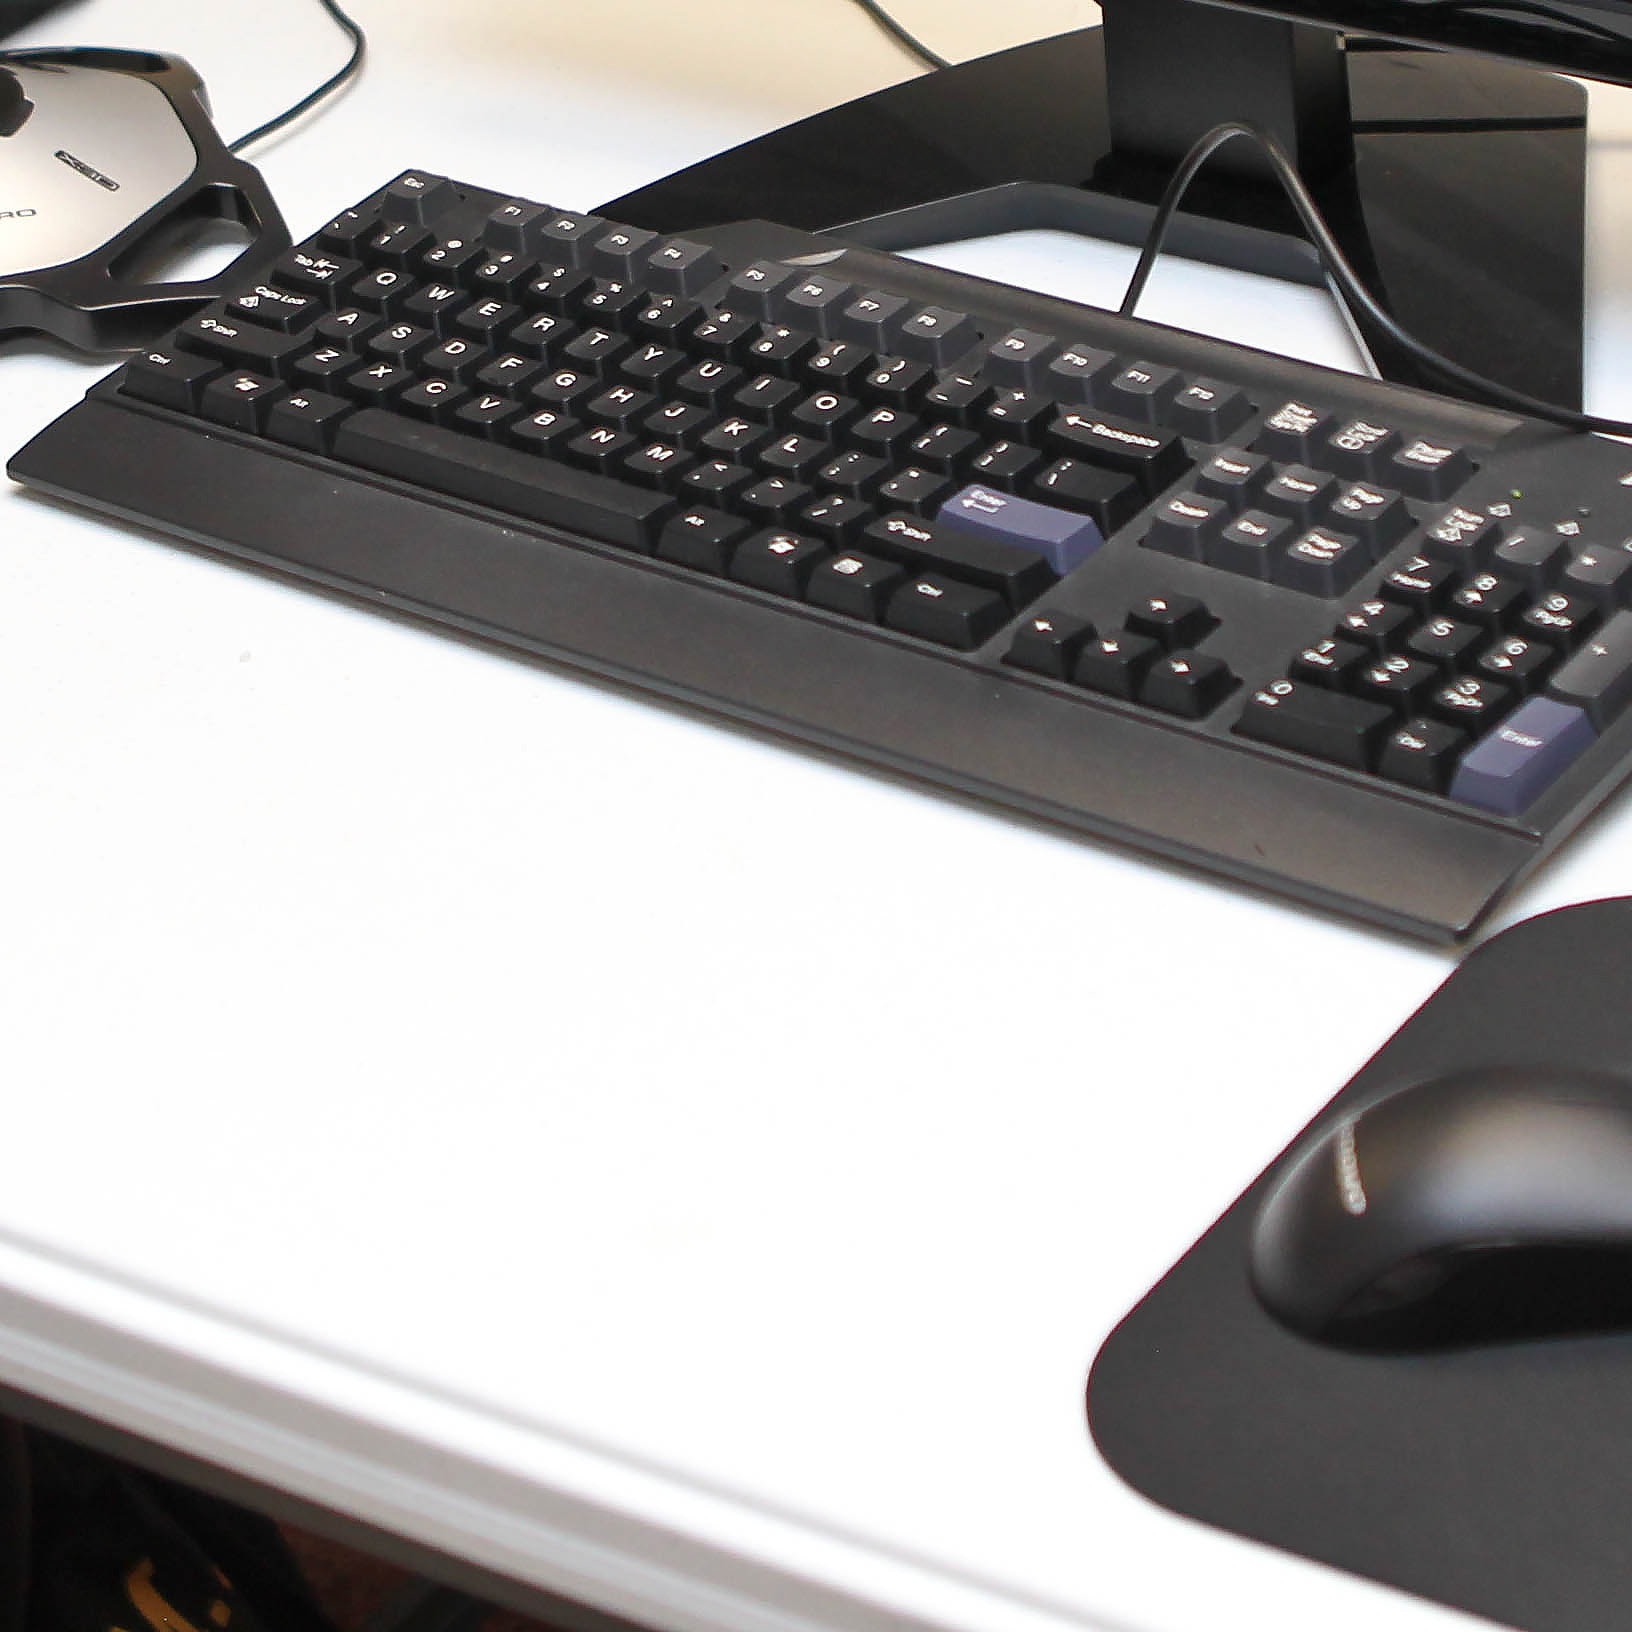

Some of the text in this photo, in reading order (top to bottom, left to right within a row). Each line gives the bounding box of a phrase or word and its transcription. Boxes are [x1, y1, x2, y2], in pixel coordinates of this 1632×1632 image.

[429, 287, 454, 300] W
[479, 303, 501, 315] E
[337, 313, 357, 324] A
[533, 318, 554, 331] R
[392, 327, 411, 338] S
[590, 332, 608, 344] T
[445, 342, 465, 354] D
[645, 348, 663, 360] Y
[315, 350, 339, 361] Z
[500, 358, 523, 368] F
[369, 366, 392, 377] X
[700, 363, 721, 376] U
[556, 371, 576, 386] G
[426, 383, 448, 393] C
[609, 389, 633, 402] H
[480, 398, 500, 408] V
[665, 408, 685, 416] J
[872, 411, 894, 422] P
[534, 413, 555, 425] B
[724, 422, 748, 435] K
[591, 431, 615, 443] N
[782, 439, 798, 452] L
[646, 447, 673, 460] M
